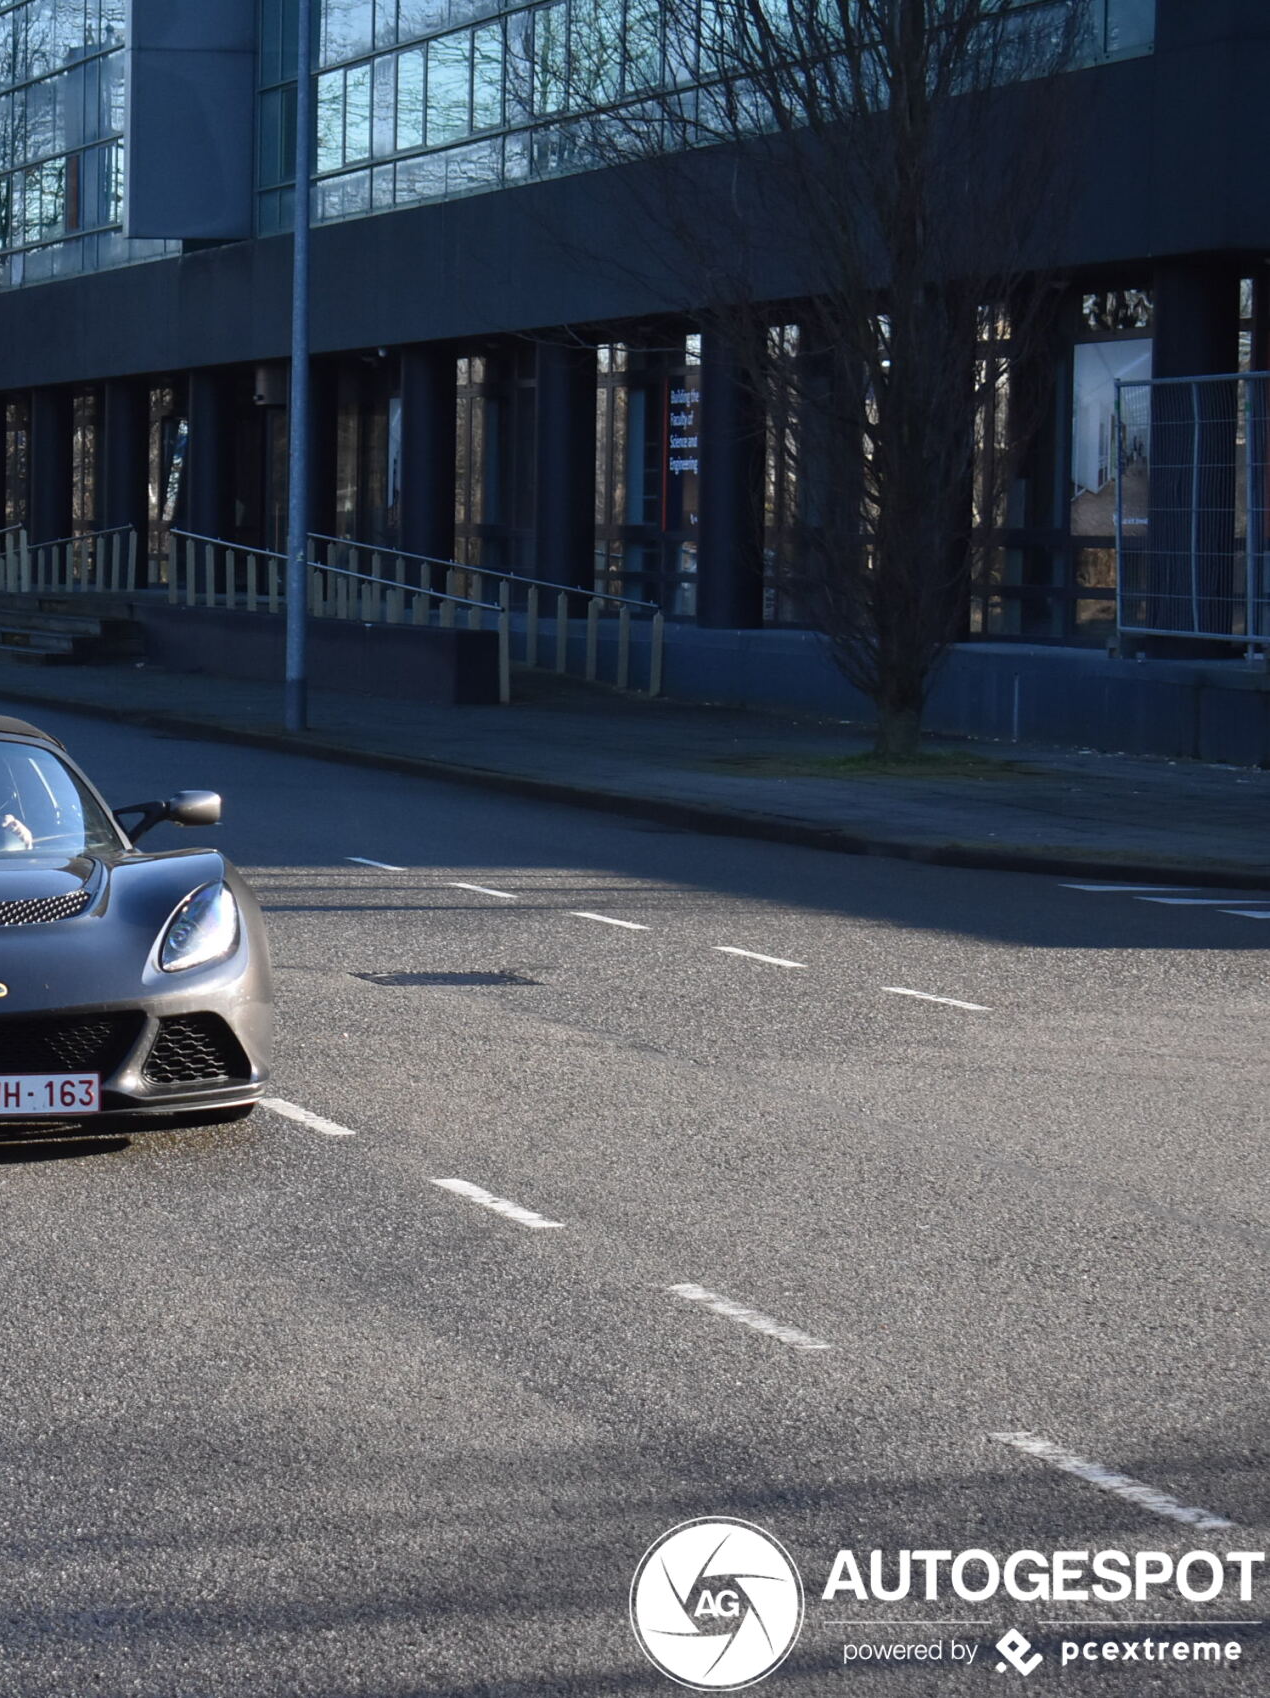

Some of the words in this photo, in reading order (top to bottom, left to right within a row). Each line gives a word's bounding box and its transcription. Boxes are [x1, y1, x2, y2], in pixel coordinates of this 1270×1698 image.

[671, 389, 690, 407] Building
[691, 389, 699, 403] the
[670, 411, 687, 430] Faculty
[688, 410, 694, 425] of
[670, 434, 687, 448] Science
[688, 434, 697, 448] and
[670, 456, 698, 475] Engineering
